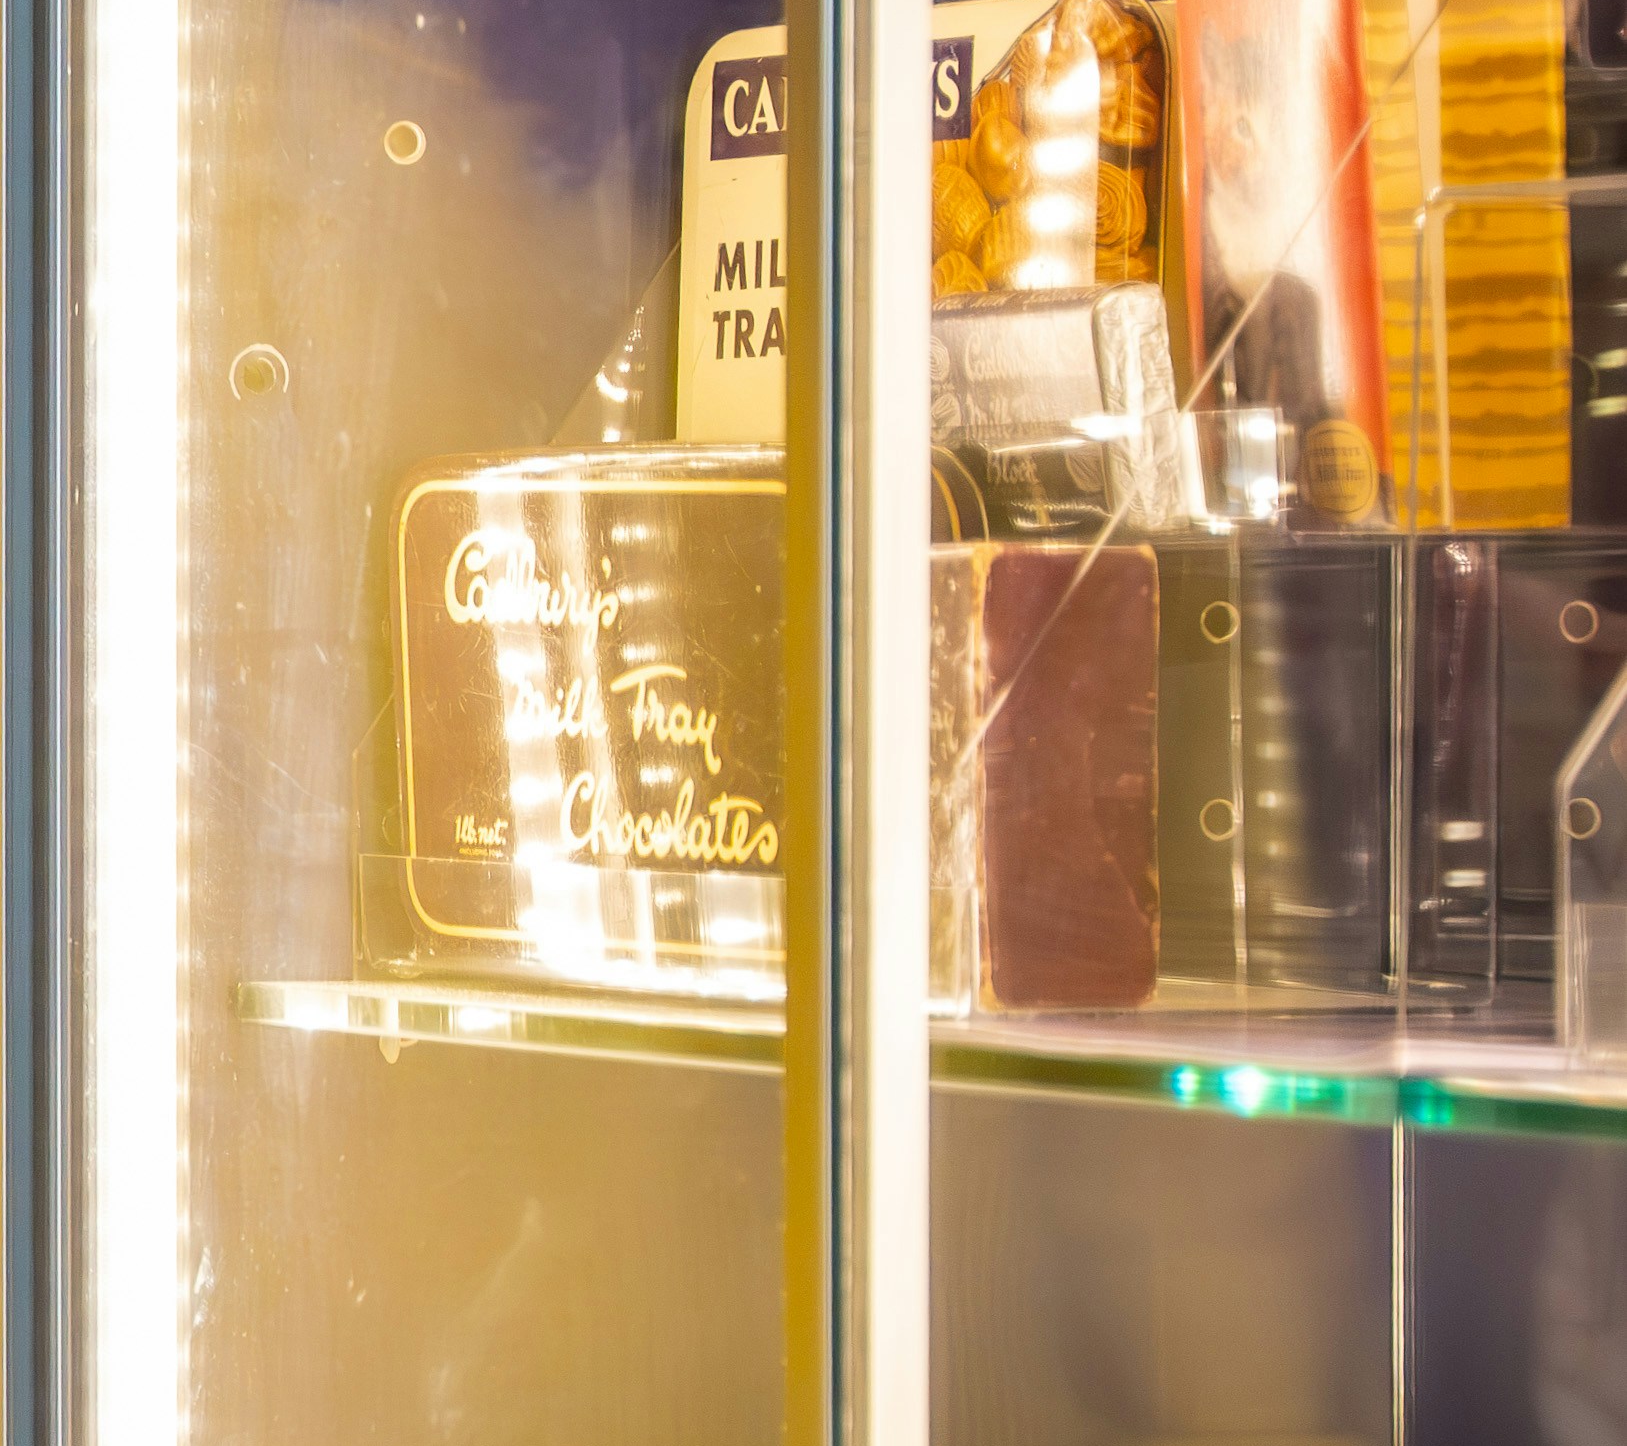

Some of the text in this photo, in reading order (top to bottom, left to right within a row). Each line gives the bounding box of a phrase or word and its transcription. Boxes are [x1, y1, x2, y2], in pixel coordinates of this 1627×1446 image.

[714, 238, 786, 293] MIL
[712, 306, 786, 360] TRA
[610, 664, 722, 775] Tray
[560, 771, 779, 865] Chocolates
